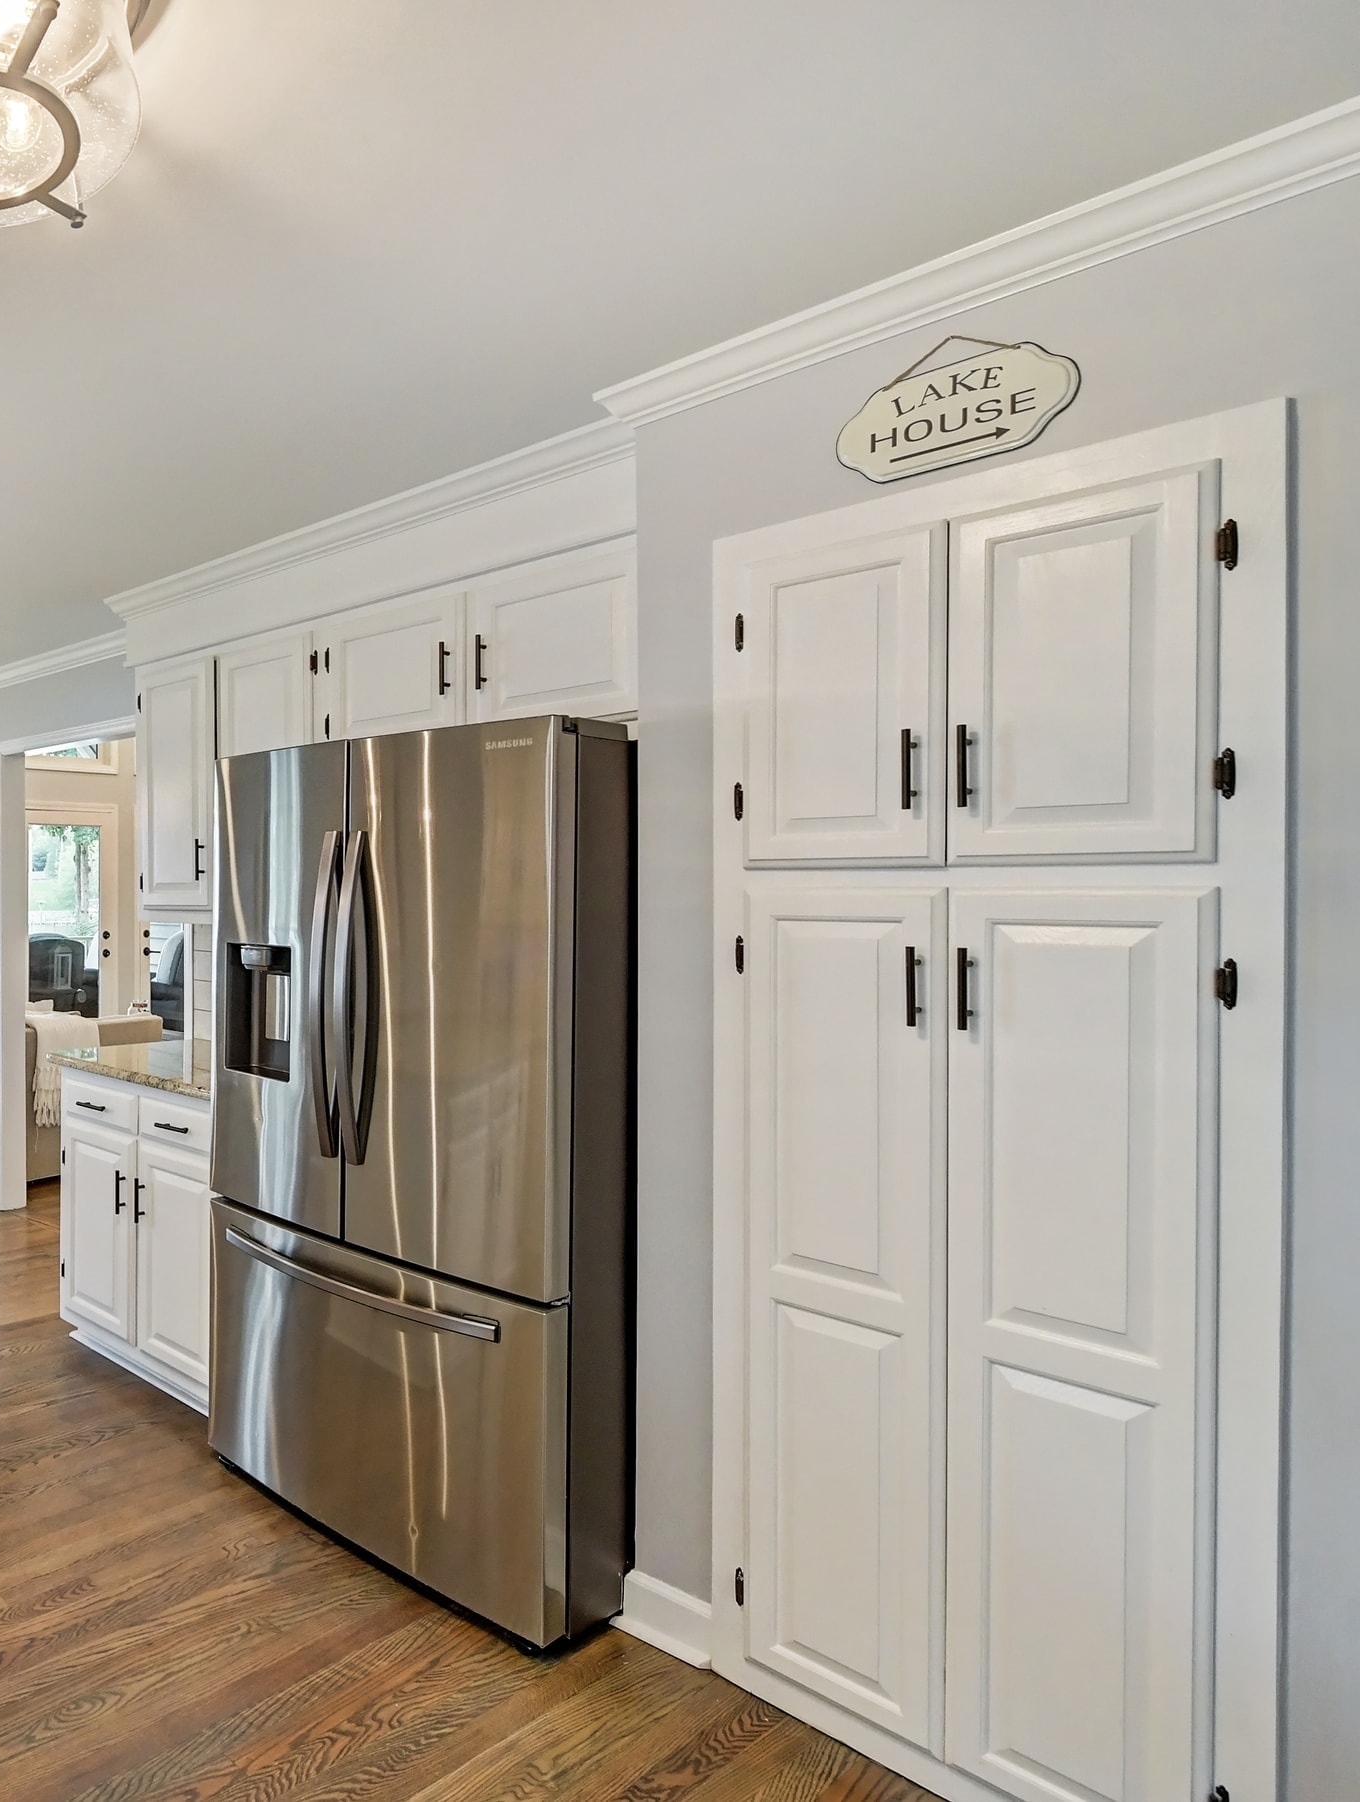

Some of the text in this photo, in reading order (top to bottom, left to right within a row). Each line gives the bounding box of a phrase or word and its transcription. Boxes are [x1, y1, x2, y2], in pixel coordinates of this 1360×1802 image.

[890, 366, 1003, 418] LAKE
[870, 388, 1036, 453] HOUSE
[485, 737, 533, 750] SAMSUNG
